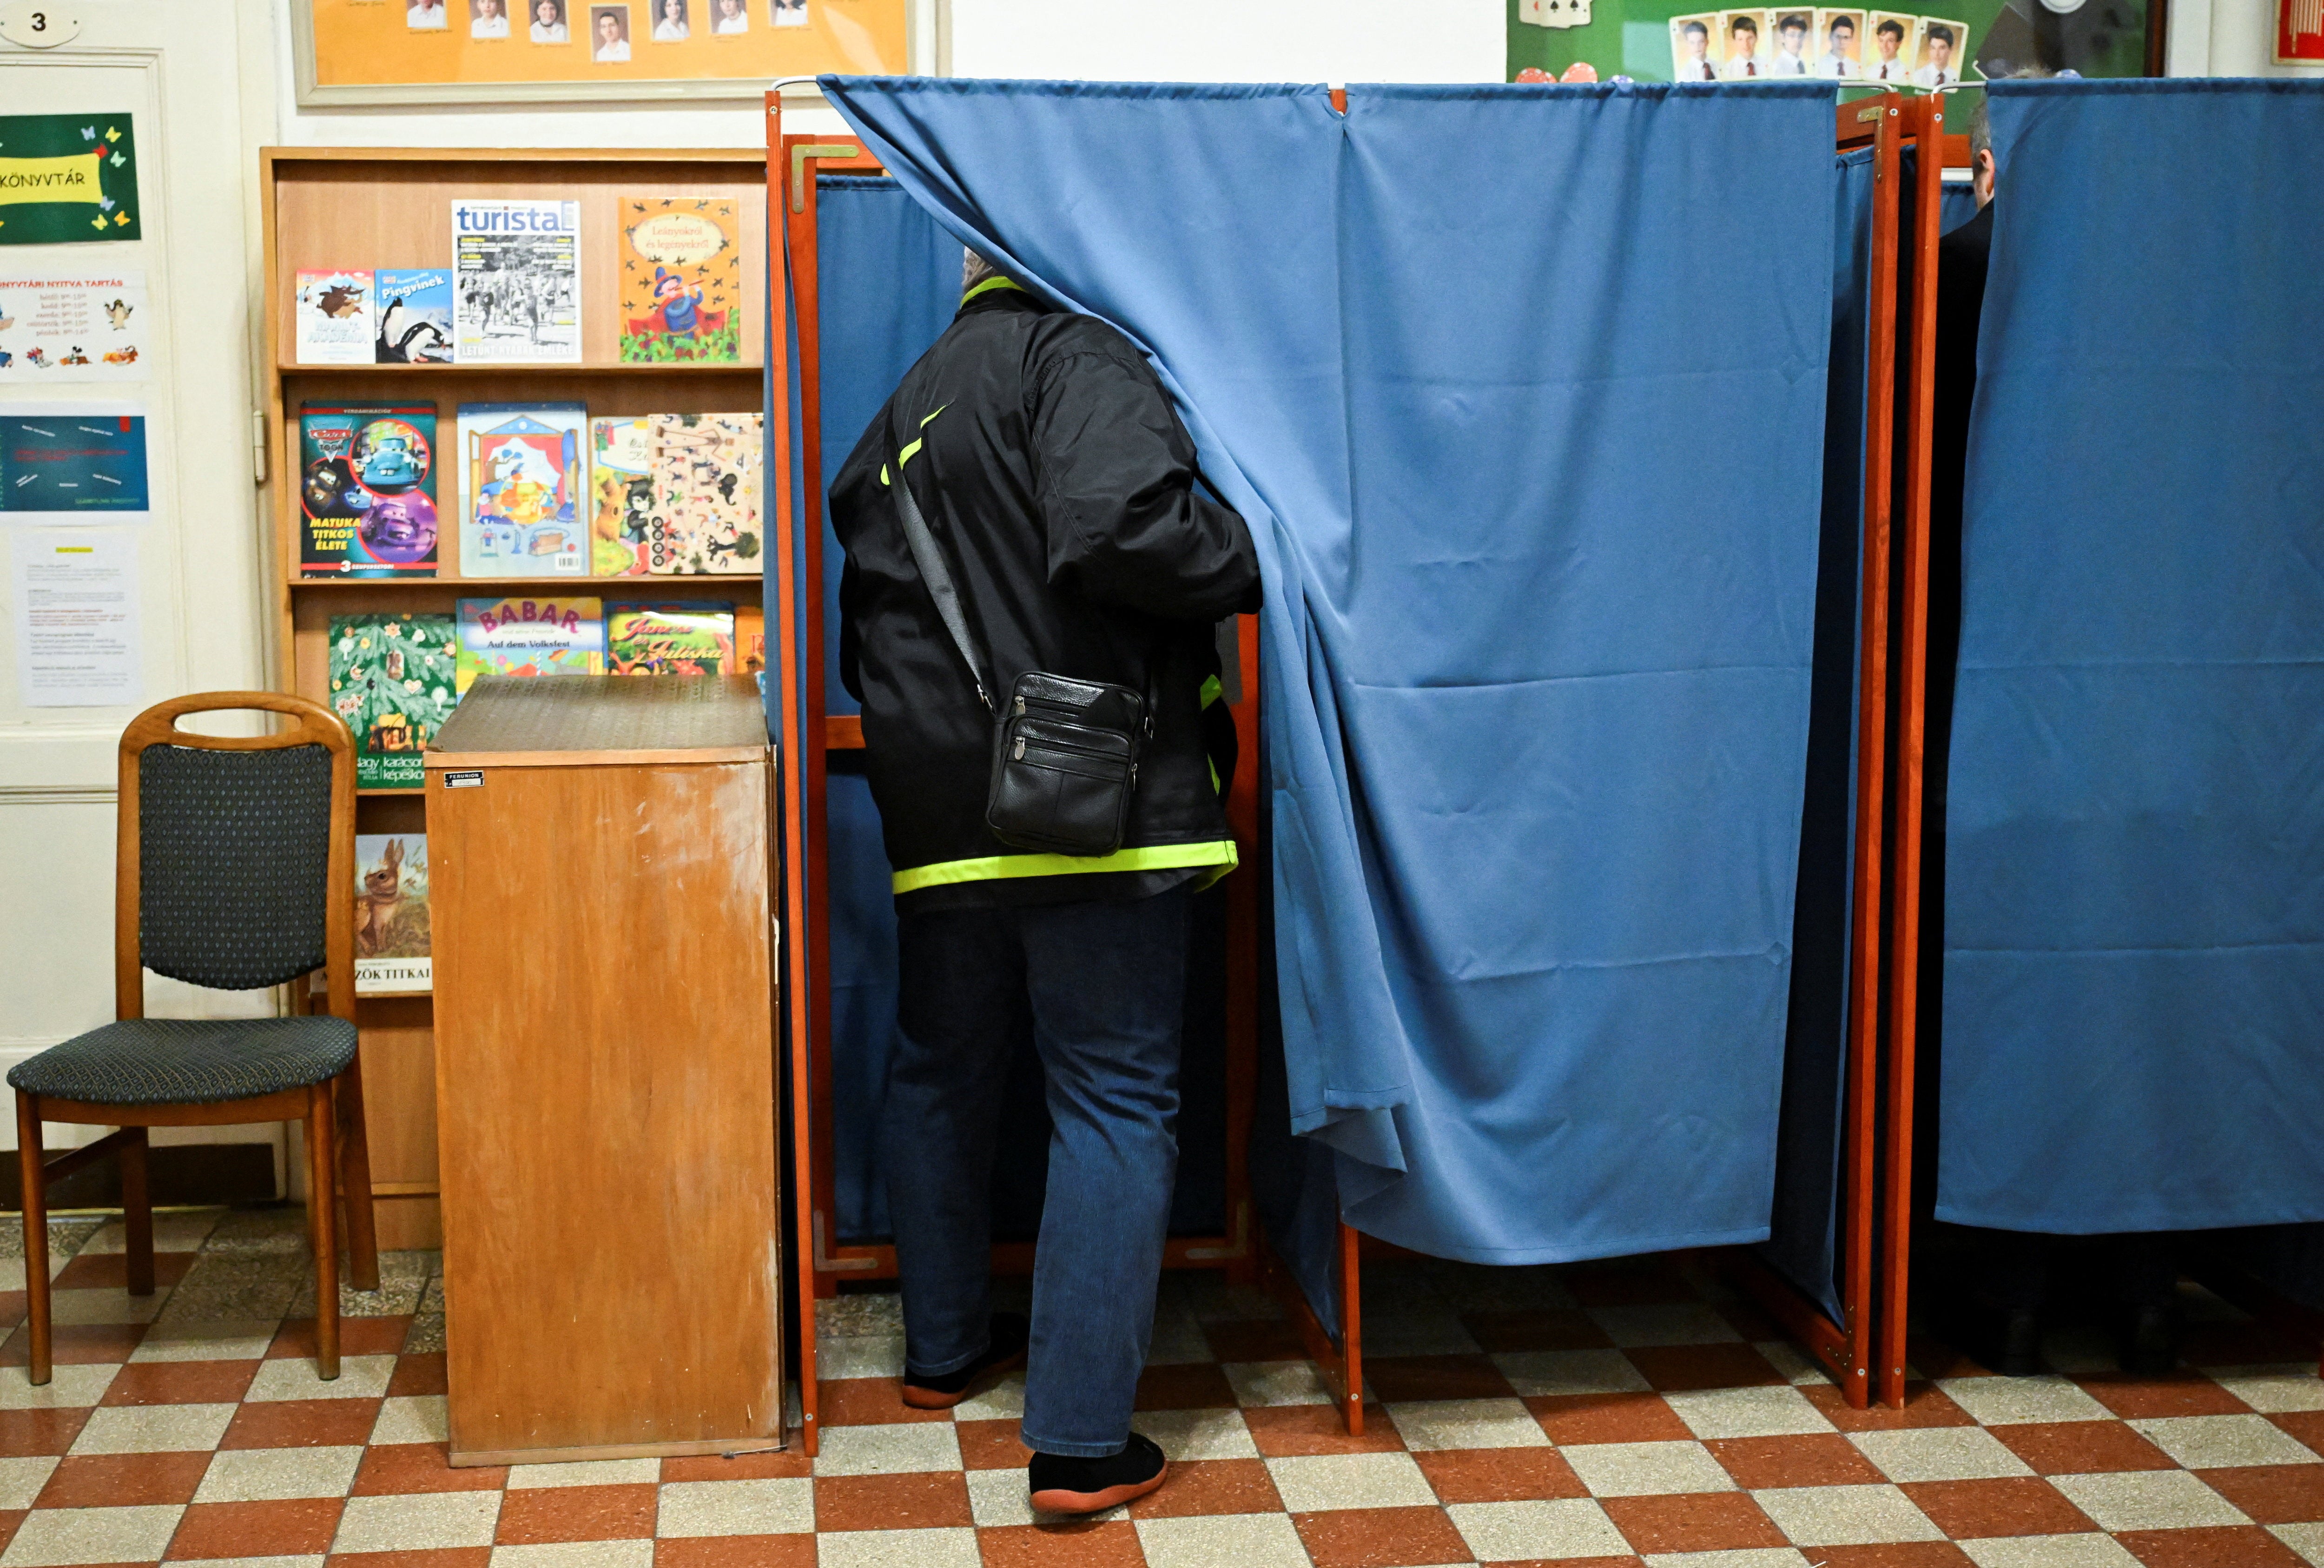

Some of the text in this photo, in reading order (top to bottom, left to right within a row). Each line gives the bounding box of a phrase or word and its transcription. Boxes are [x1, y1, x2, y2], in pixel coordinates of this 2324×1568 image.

[32, 13, 46, 31] 3
[0, 168, 85, 188] KÖNYVTÁR
[646, 239, 655, 248] és
[85, 278, 123, 287] TARTÁS
[382, 275, 445, 299] Pingvinek
[310, 518, 361, 527] MATUKA
[313, 529, 354, 539] TITKOS
[316, 539, 348, 550] ÉLETE
[340, 560, 351, 572] 3
[478, 600, 580, 633] BABAR
